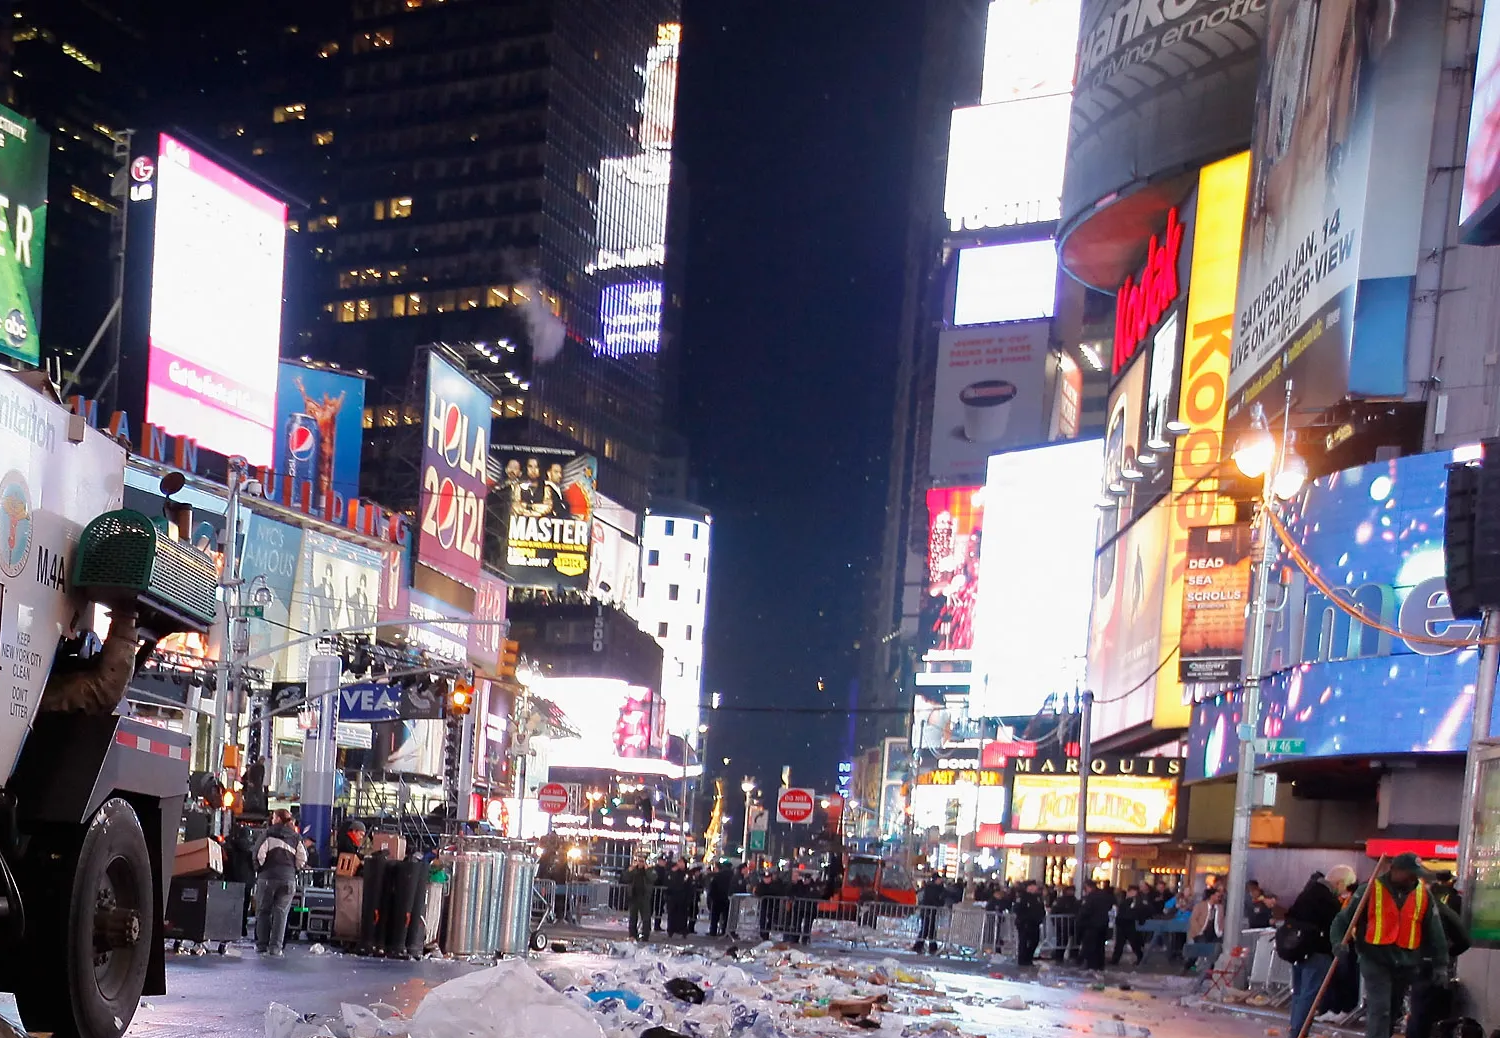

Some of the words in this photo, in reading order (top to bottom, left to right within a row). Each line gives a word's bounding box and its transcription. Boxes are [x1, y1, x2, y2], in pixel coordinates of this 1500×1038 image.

[1240, 258, 1290, 337] SATURDAY
[1291, 231, 1318, 276] JAN.
[1322, 208, 1341, 245] 14
[1112, 206, 1185, 376] Kodak
[1229, 334, 1251, 375] LIVE
[1251, 322, 1266, 353] ON
[1267, 228, 1357, 336] PAY-PER-VIEW
[4, 316, 28, 340] abc
[428, 391, 487, 485] HOLA
[257, 465, 407, 545] UILDING
[421, 466, 485, 561] 2012!
[509, 515, 588, 546] MASTER
[36, 545, 66, 594] M.4A
[244, 543, 296, 577] AMOUS
[1189, 557, 1224, 570] DEAD
[1188, 574, 1212, 586] SEA
[1187, 589, 1242, 602] SCROLLS
[17, 631, 31, 647] KEEP
[1, 642, 16, 659] NEW
[15, 647, 31, 664] YORK
[30, 652, 42, 668] CITY
[12, 663, 31, 681] CLEAN
[11, 685, 28, 703] DON'T
[341, 690, 395, 712] VEA
[10, 702, 28, 719] LITTER
[1269, 741, 1278, 752] W
[1279, 740, 1291, 752] 46
[1015, 758, 1181, 775] MARQUIS
[838, 762, 852, 799] NYP
